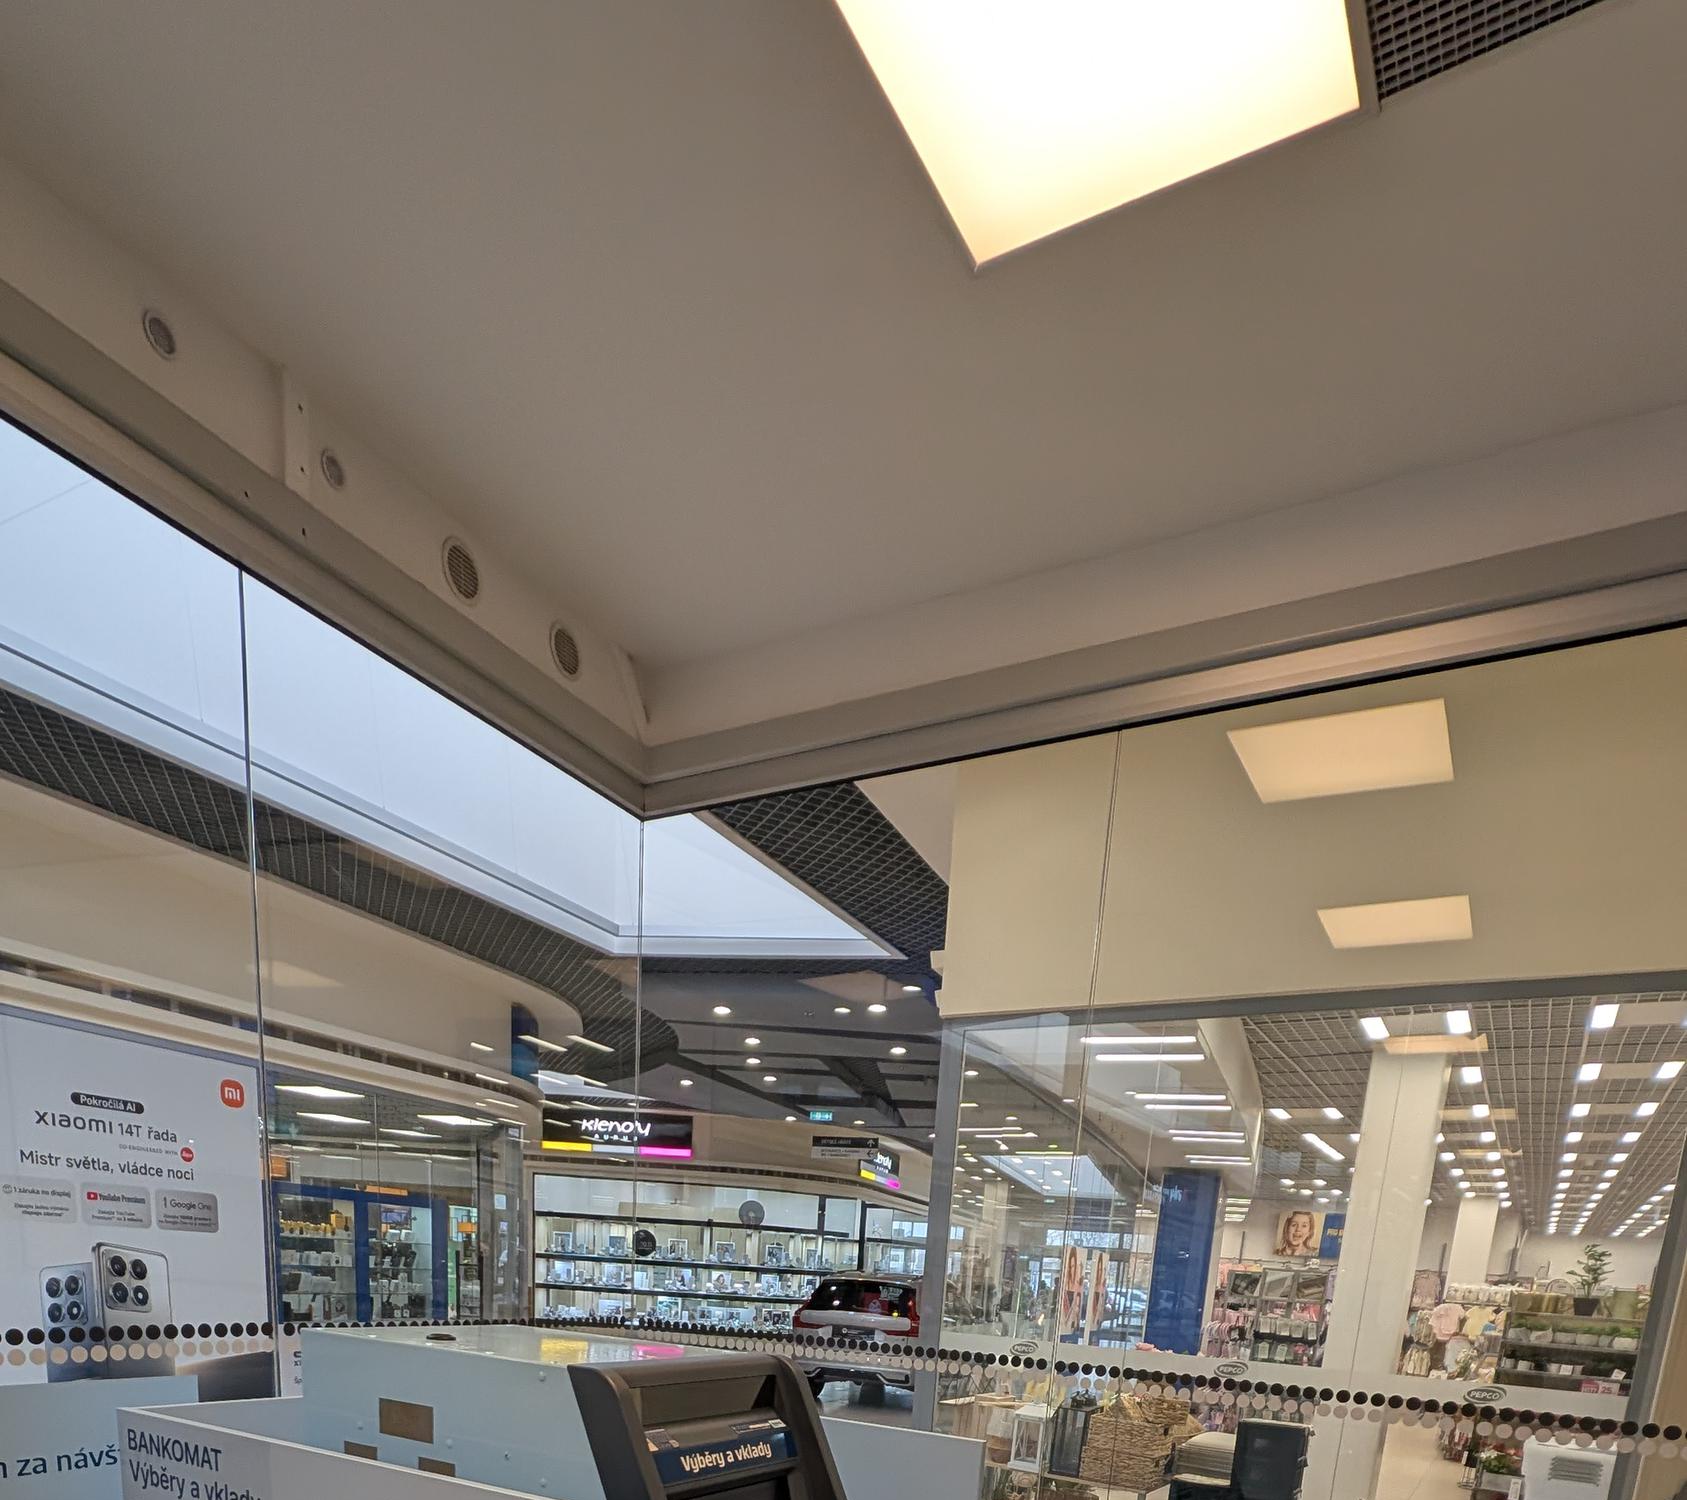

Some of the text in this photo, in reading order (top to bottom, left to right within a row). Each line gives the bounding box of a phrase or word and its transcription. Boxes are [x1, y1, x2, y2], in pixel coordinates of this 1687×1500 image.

[80, 1094, 136, 1112] Pokročilá AI
[118, 1122, 142, 1138] 14T
[147, 1126, 177, 1143] řada
[20, 1150, 195, 1181] Mistr světla, vládce noci
[170, 1199, 196, 1211] Google
[1470, 1390, 1500, 1399] PEPCO
[17, 1457, 47, 1477] za
[57, 1444, 120, 1472] návš
[128, 1429, 222, 1472] BANKOMAT
[680, 1442, 772, 1473] Výběry a vklady
[129, 1459, 185, 1499] Výběry
[190, 1480, 200, 1499] a
